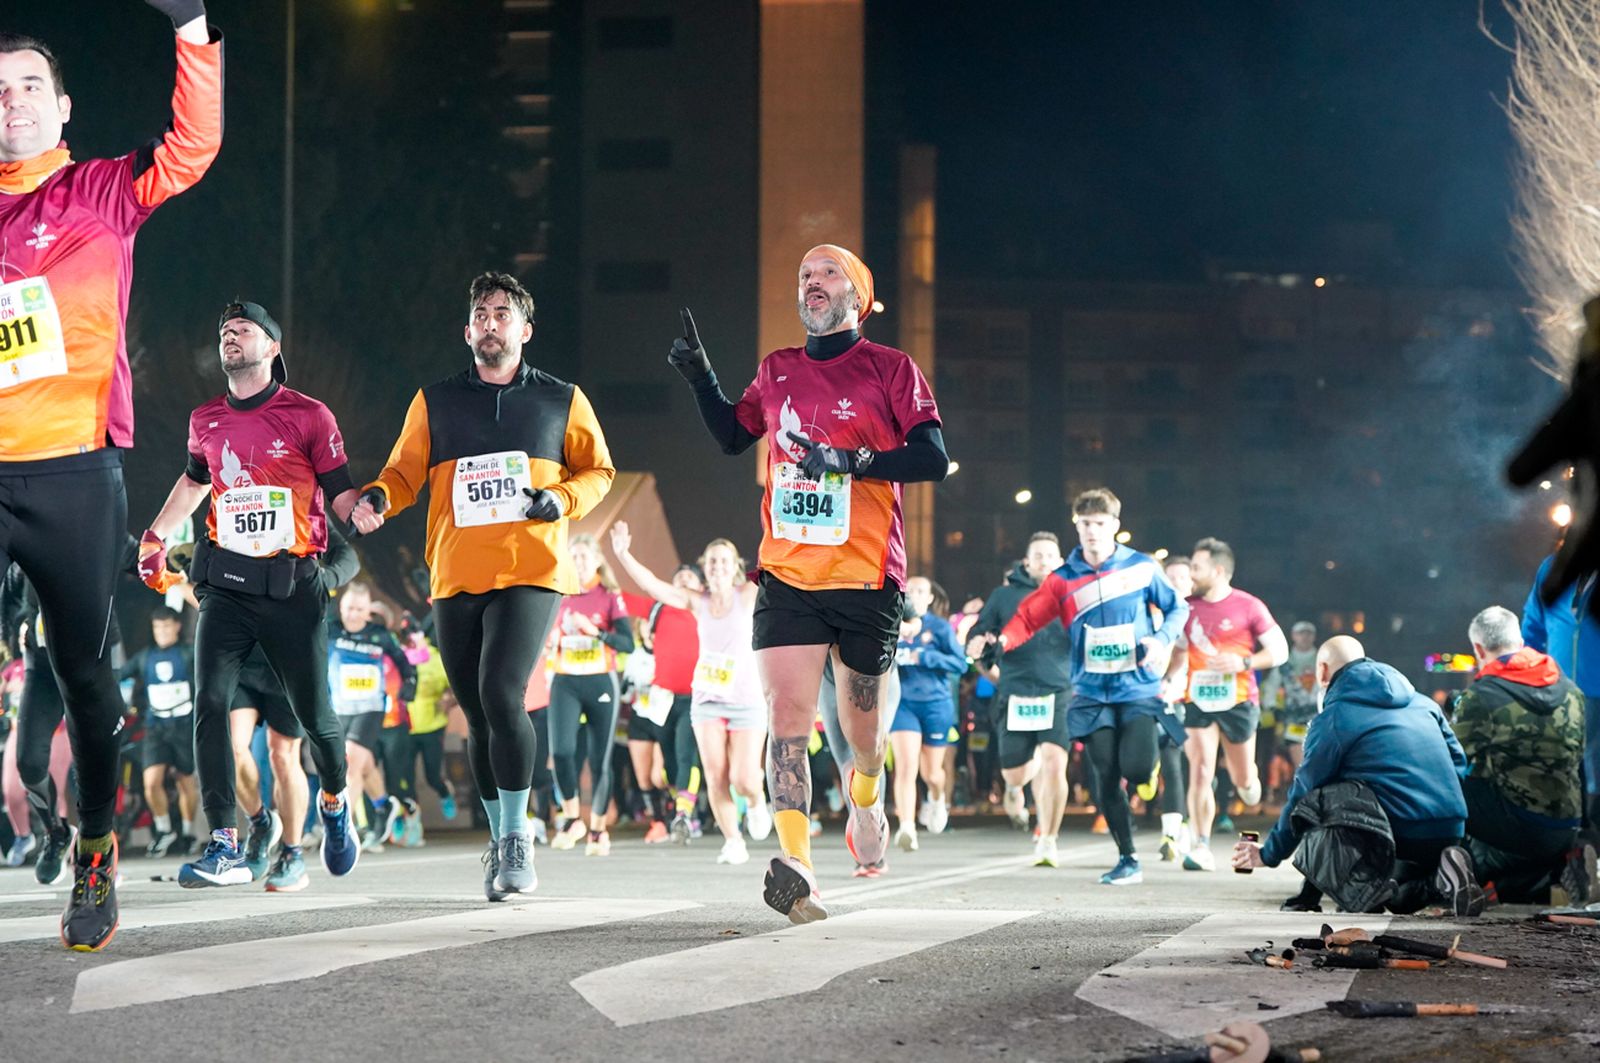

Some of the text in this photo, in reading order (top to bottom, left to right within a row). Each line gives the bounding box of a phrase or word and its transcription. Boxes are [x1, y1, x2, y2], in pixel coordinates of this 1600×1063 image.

[459, 473, 474, 482] SAN
[467, 477, 517, 502] 5679
[233, 494, 253, 503] NOCHE
[225, 504, 240, 513] SAN
[234, 510, 276, 534] 5677
